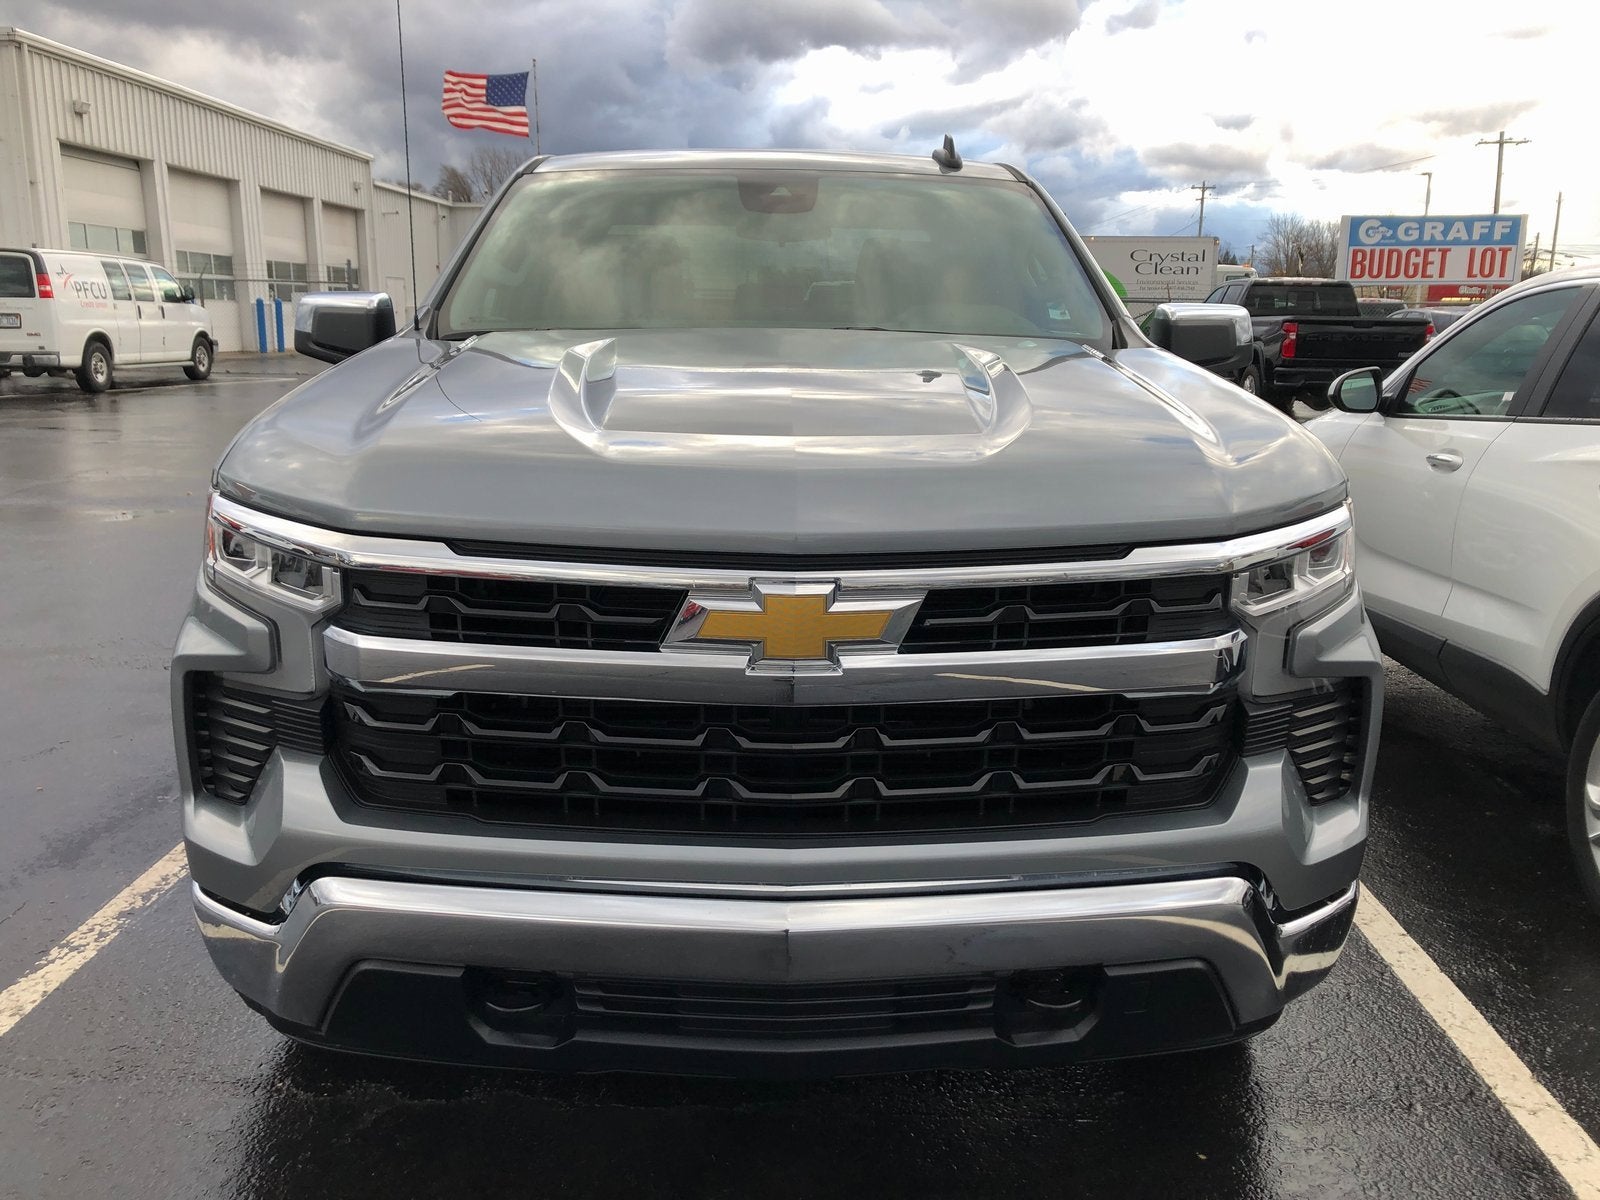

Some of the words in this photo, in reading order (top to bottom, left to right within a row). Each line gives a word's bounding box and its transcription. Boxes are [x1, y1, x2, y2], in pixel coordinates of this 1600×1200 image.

[1397, 221, 1512, 241] GRAFF
[1130, 249, 1205, 265] Crystal
[1350, 248, 1451, 279] BUDGET
[1467, 247, 1512, 278] LOT
[1135, 262, 1199, 275] Clean
[74, 280, 107, 299] PFCU
